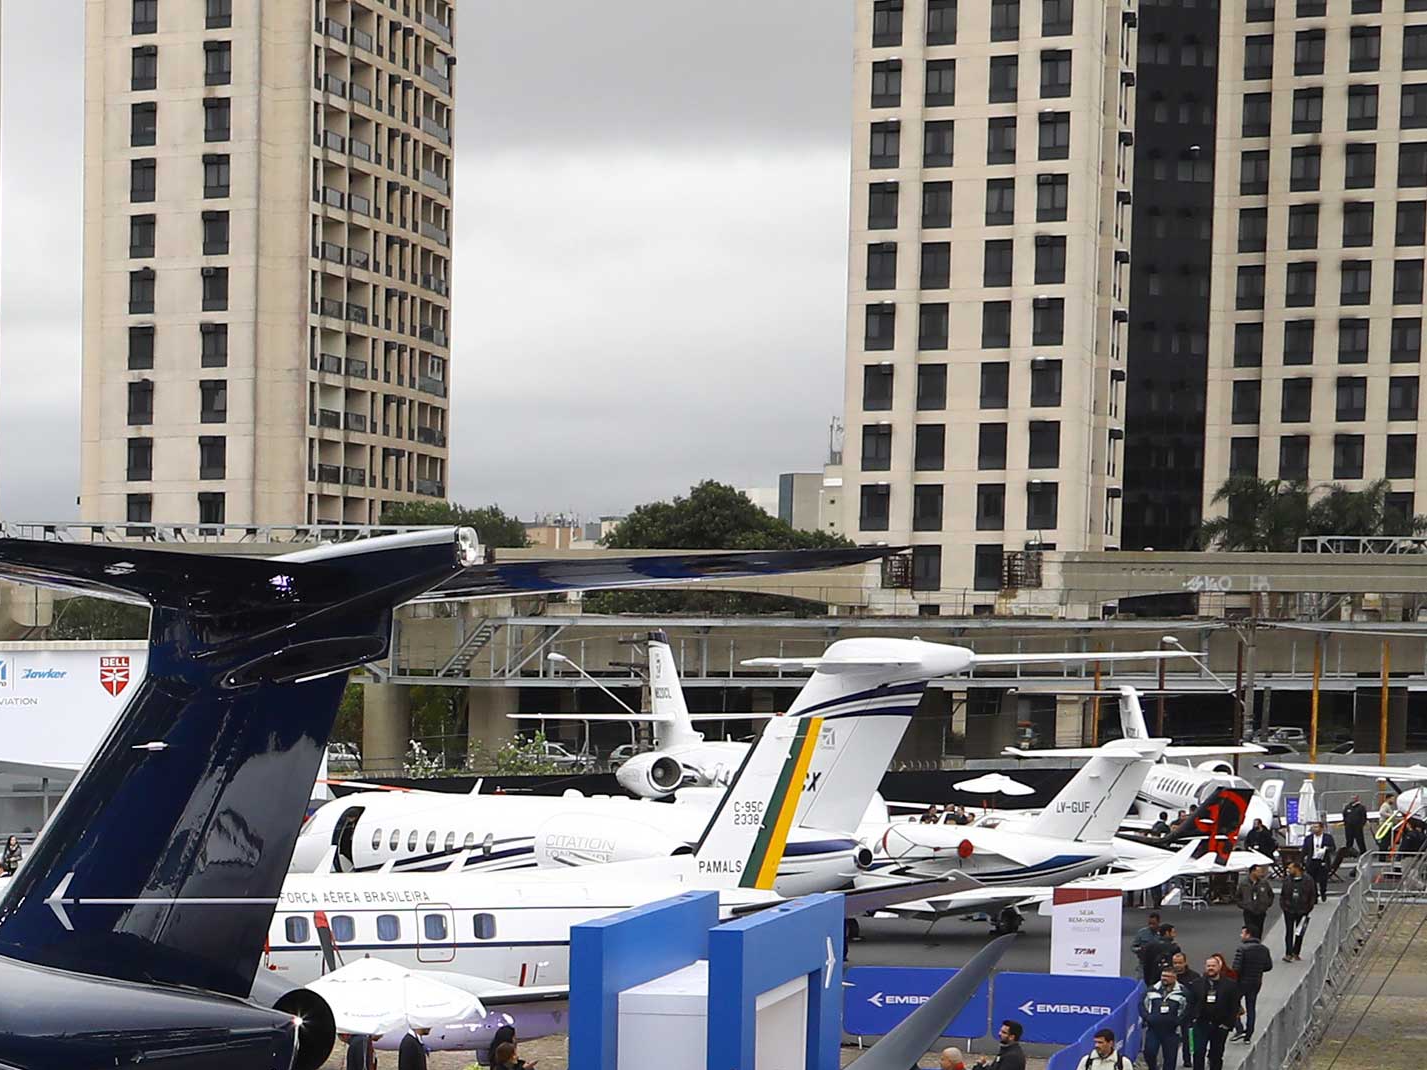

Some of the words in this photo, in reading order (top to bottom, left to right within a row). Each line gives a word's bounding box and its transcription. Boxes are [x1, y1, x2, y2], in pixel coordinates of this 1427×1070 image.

[102, 657, 128, 667] BELL
[733, 801, 763, 813] C-95C
[1056, 801, 1091, 813] LV-GUF
[733, 813, 760, 825] 2338
[545, 833, 616, 851] CITATION
[698, 860, 742, 873] PAMALS
[280, 892, 318, 904] FORÇA
[323, 890, 361, 903] AÉREA
[365, 890, 431, 903] BRASILEIRA
[885, 995, 932, 1005] EMBR
[1036, 1004, 1112, 1016] EMBRAER
